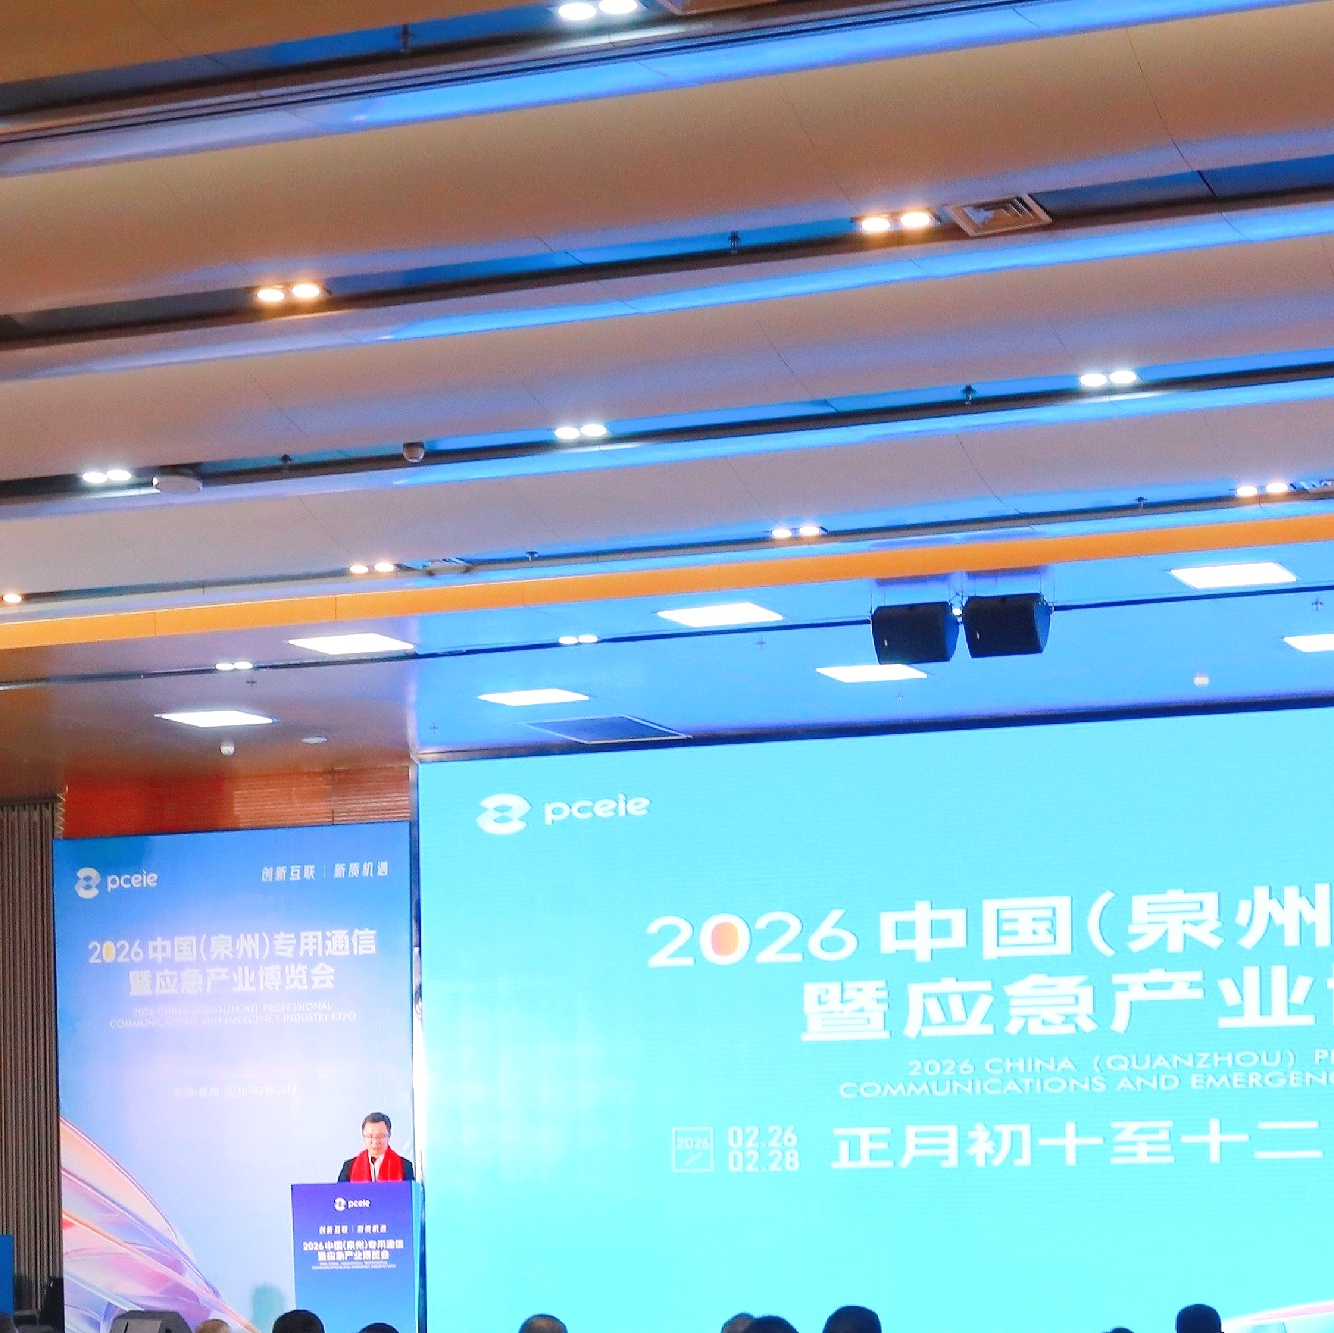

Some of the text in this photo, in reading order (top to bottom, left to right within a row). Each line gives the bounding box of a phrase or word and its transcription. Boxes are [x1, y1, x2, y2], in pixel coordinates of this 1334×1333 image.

[544, 792, 652, 827] pceie
[107, 868, 159, 893] pceie
[261, 860, 389, 883] 创新互联 新质机遇
[128, 962, 336, 996] 暨应急产业博览会
[907, 1058, 976, 1076] 2026
[983, 1056, 1077, 1074] CHINA
[838, 1075, 1107, 1099] COMMUNICATIONS
[1115, 1073, 1181, 1093] AND
[676, 1136, 710, 1150] 2026
[727, 1124, 799, 1149] 02.26
[830, 1117, 1324, 1169] 正月初十至十二
[727, 1148, 801, 1173] 02.28
